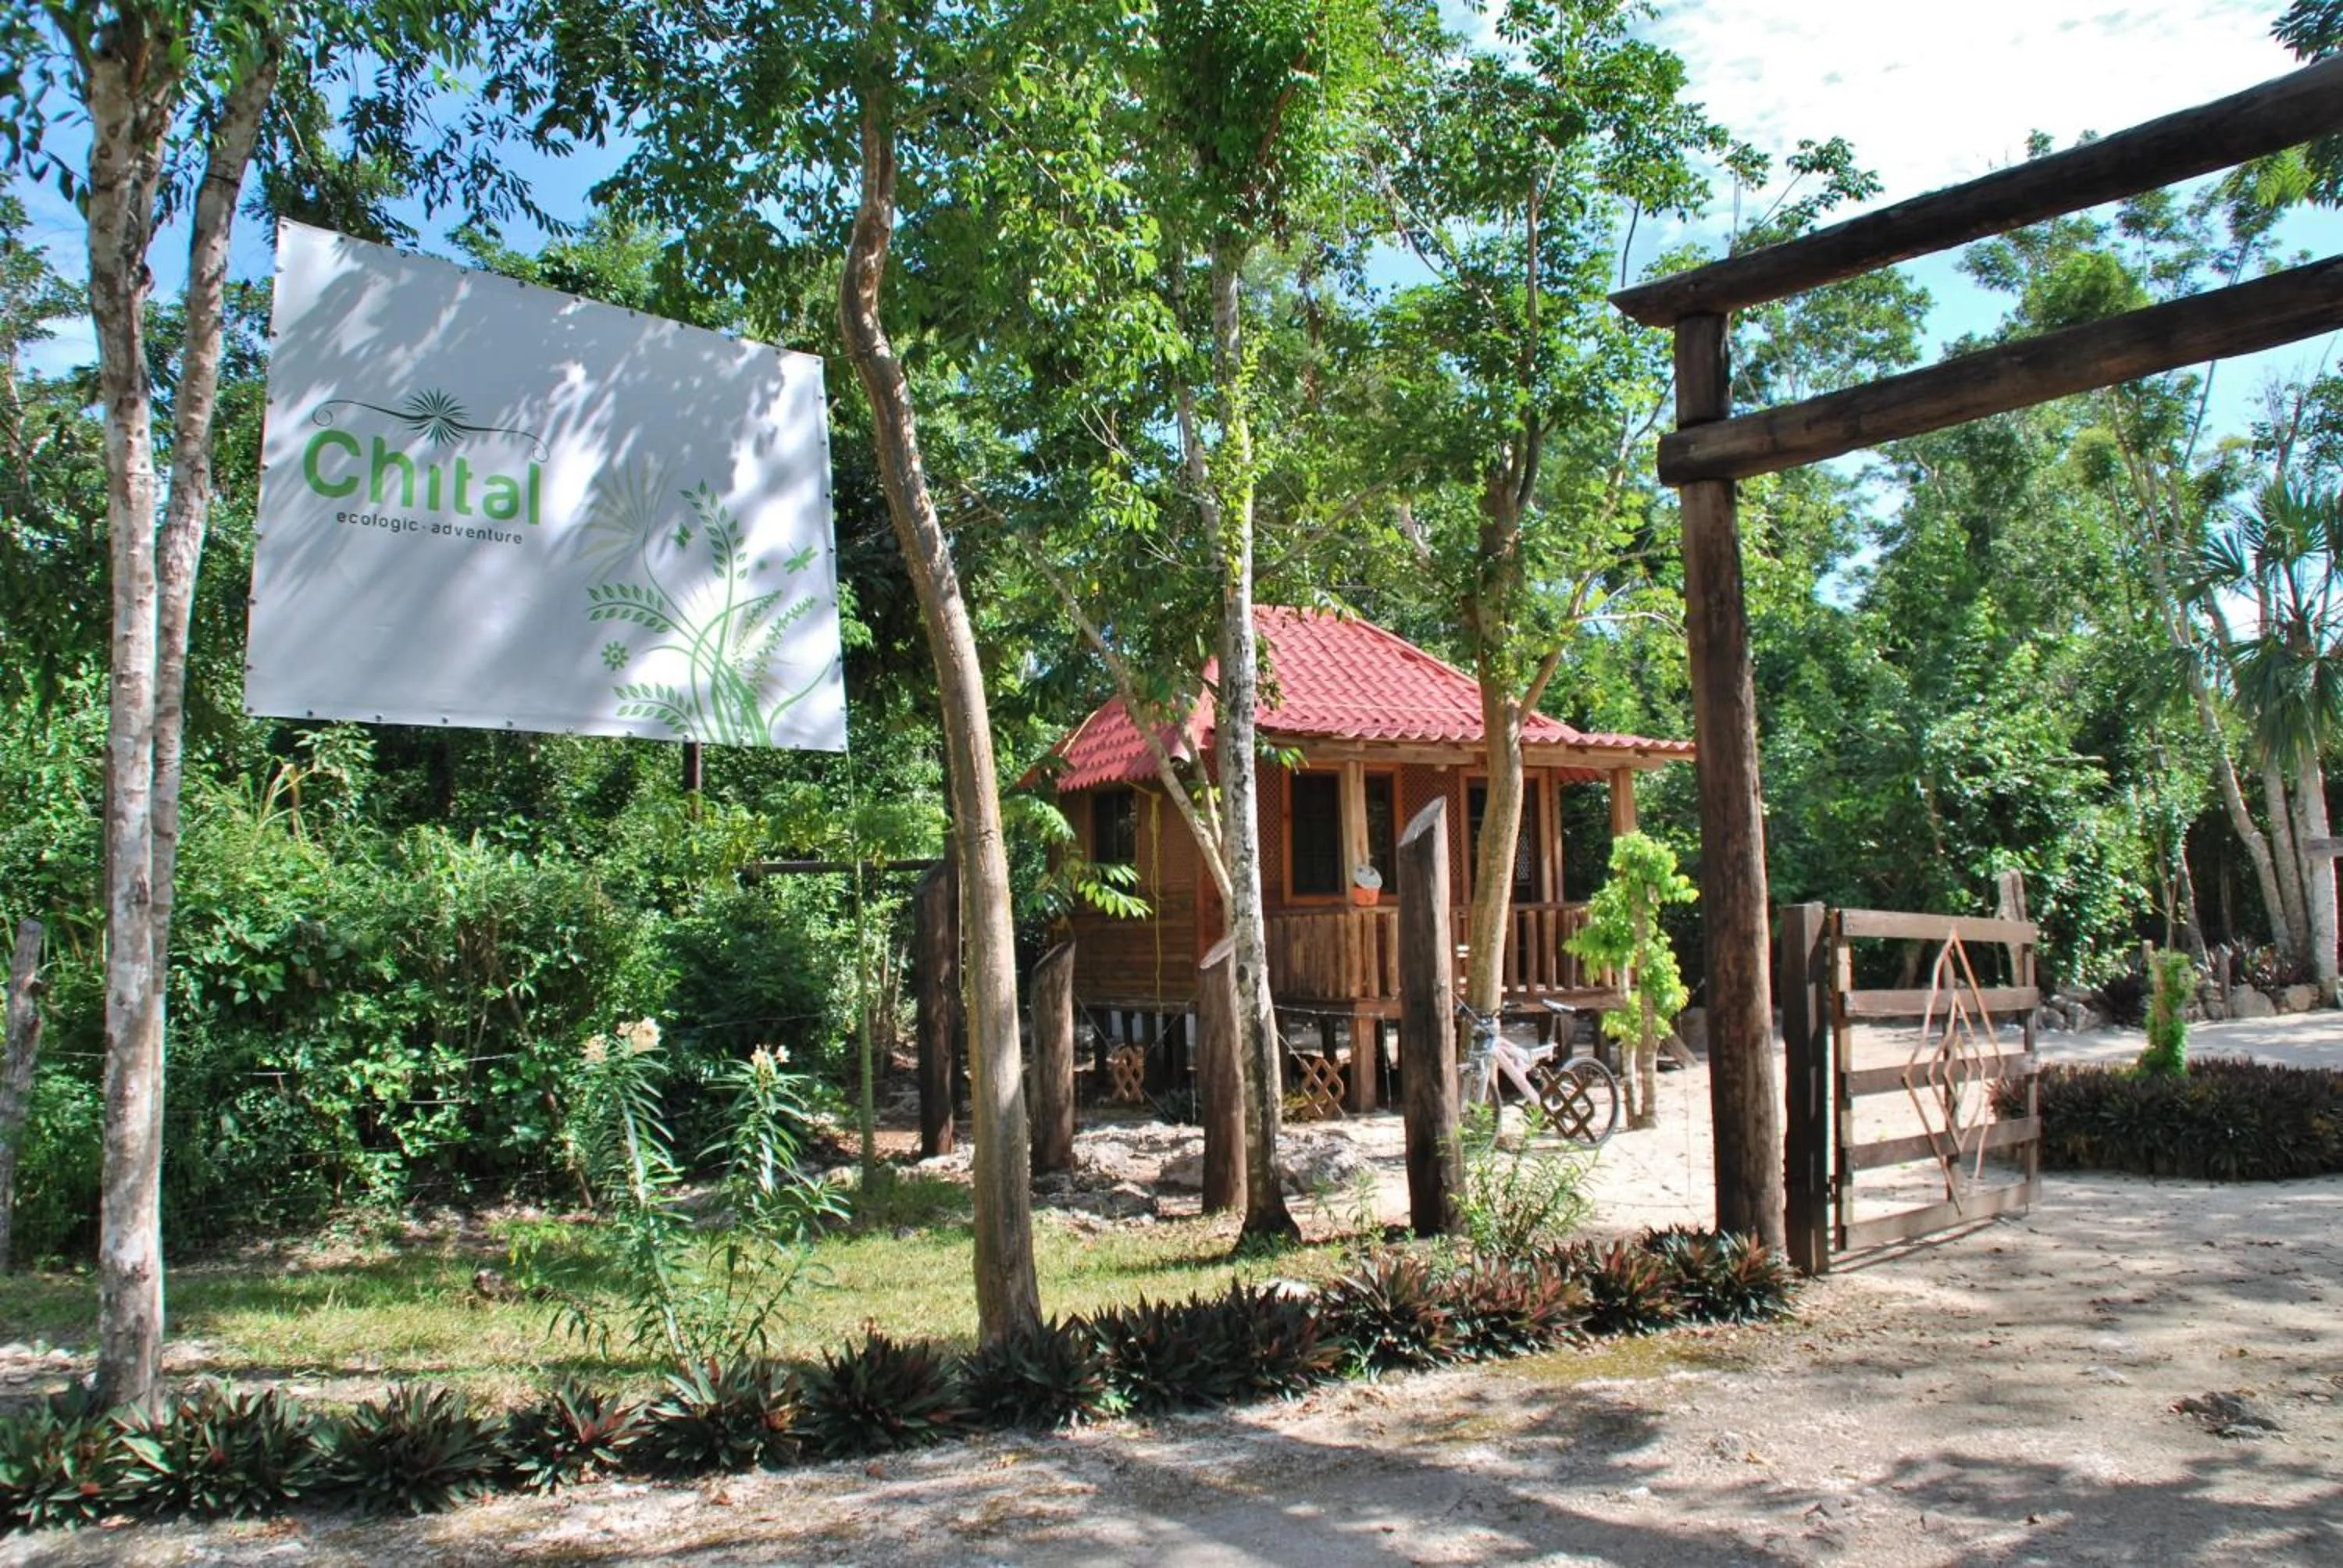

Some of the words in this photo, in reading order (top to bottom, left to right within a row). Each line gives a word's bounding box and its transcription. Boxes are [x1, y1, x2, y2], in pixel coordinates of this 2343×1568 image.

[303, 429, 540, 525] Chital
[336, 511, 419, 533] ecologic
[430, 522, 523, 544] adventure
